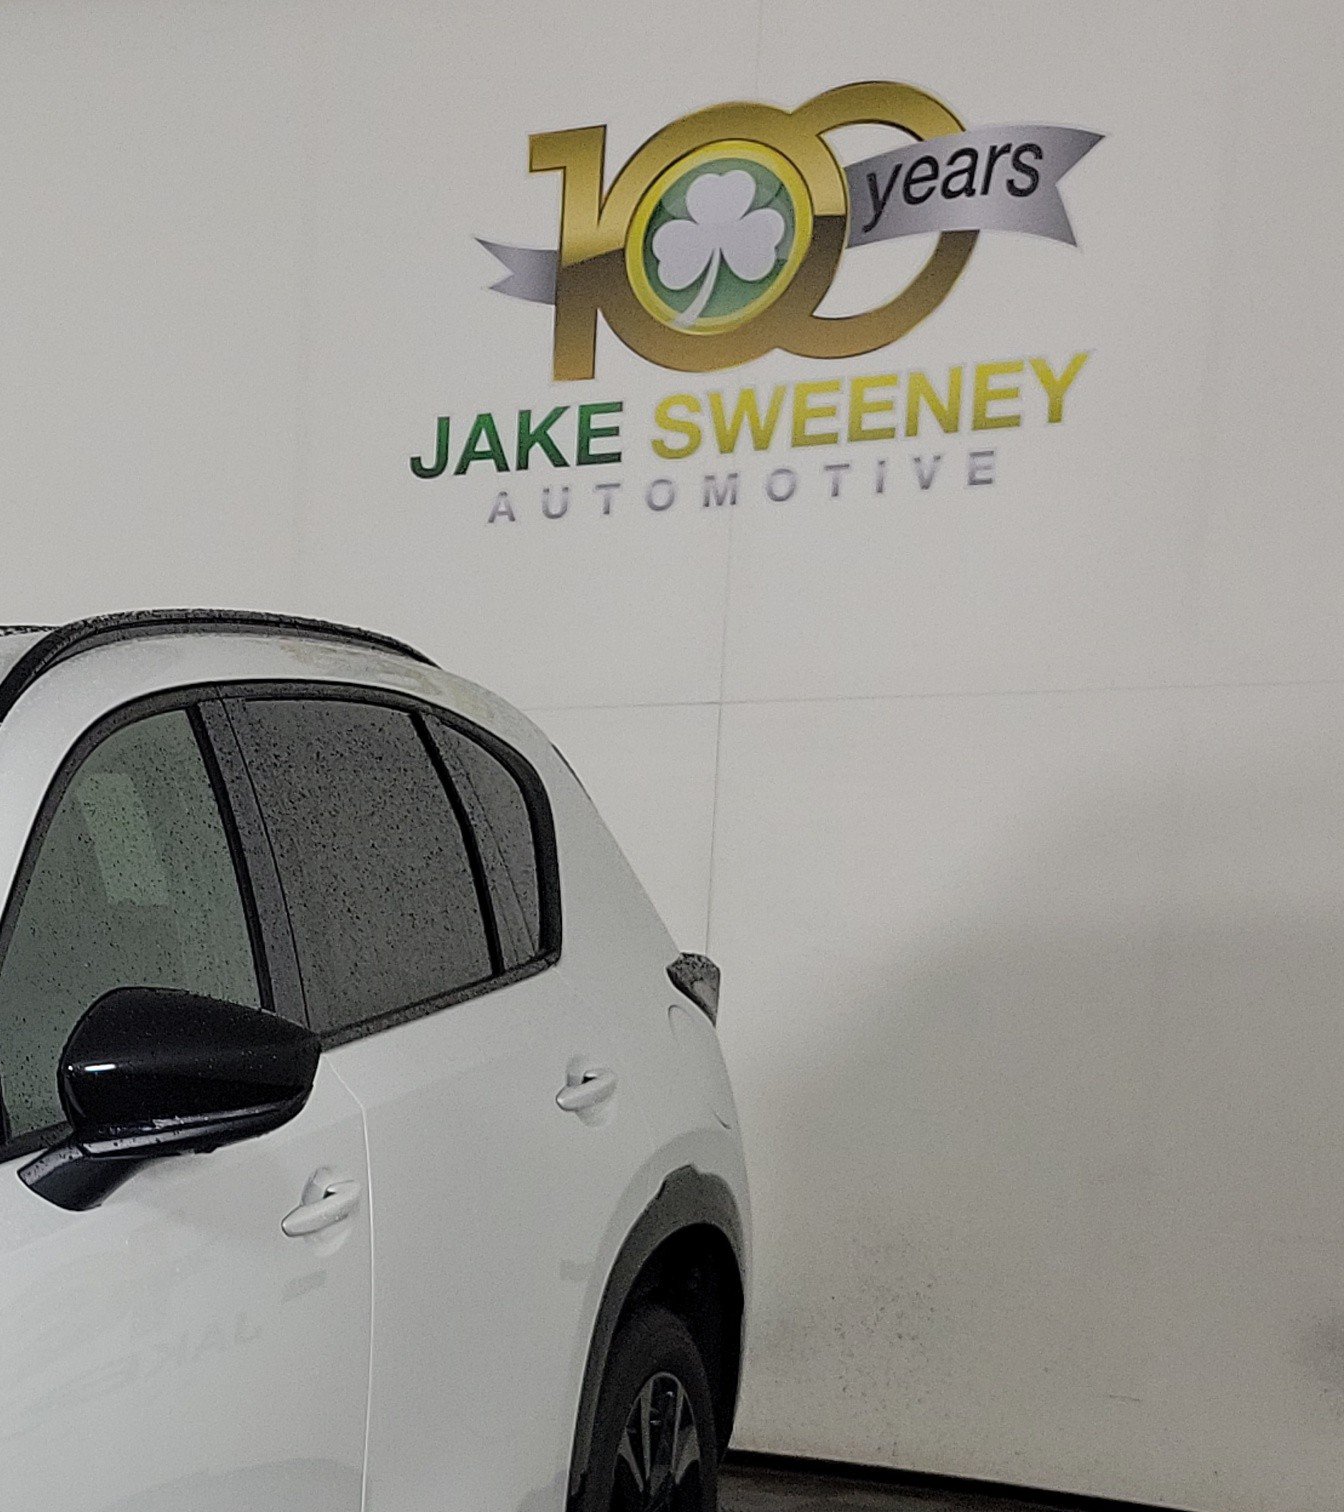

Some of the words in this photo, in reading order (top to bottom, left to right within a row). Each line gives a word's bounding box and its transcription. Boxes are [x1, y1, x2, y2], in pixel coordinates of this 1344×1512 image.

[528, 80, 982, 383] 100
[863, 139, 1044, 231] years
[410, 400, 624, 480] JAKE
[650, 351, 1092, 461] SWEENEY
[487, 450, 998, 525] AUTOMOTIVE
